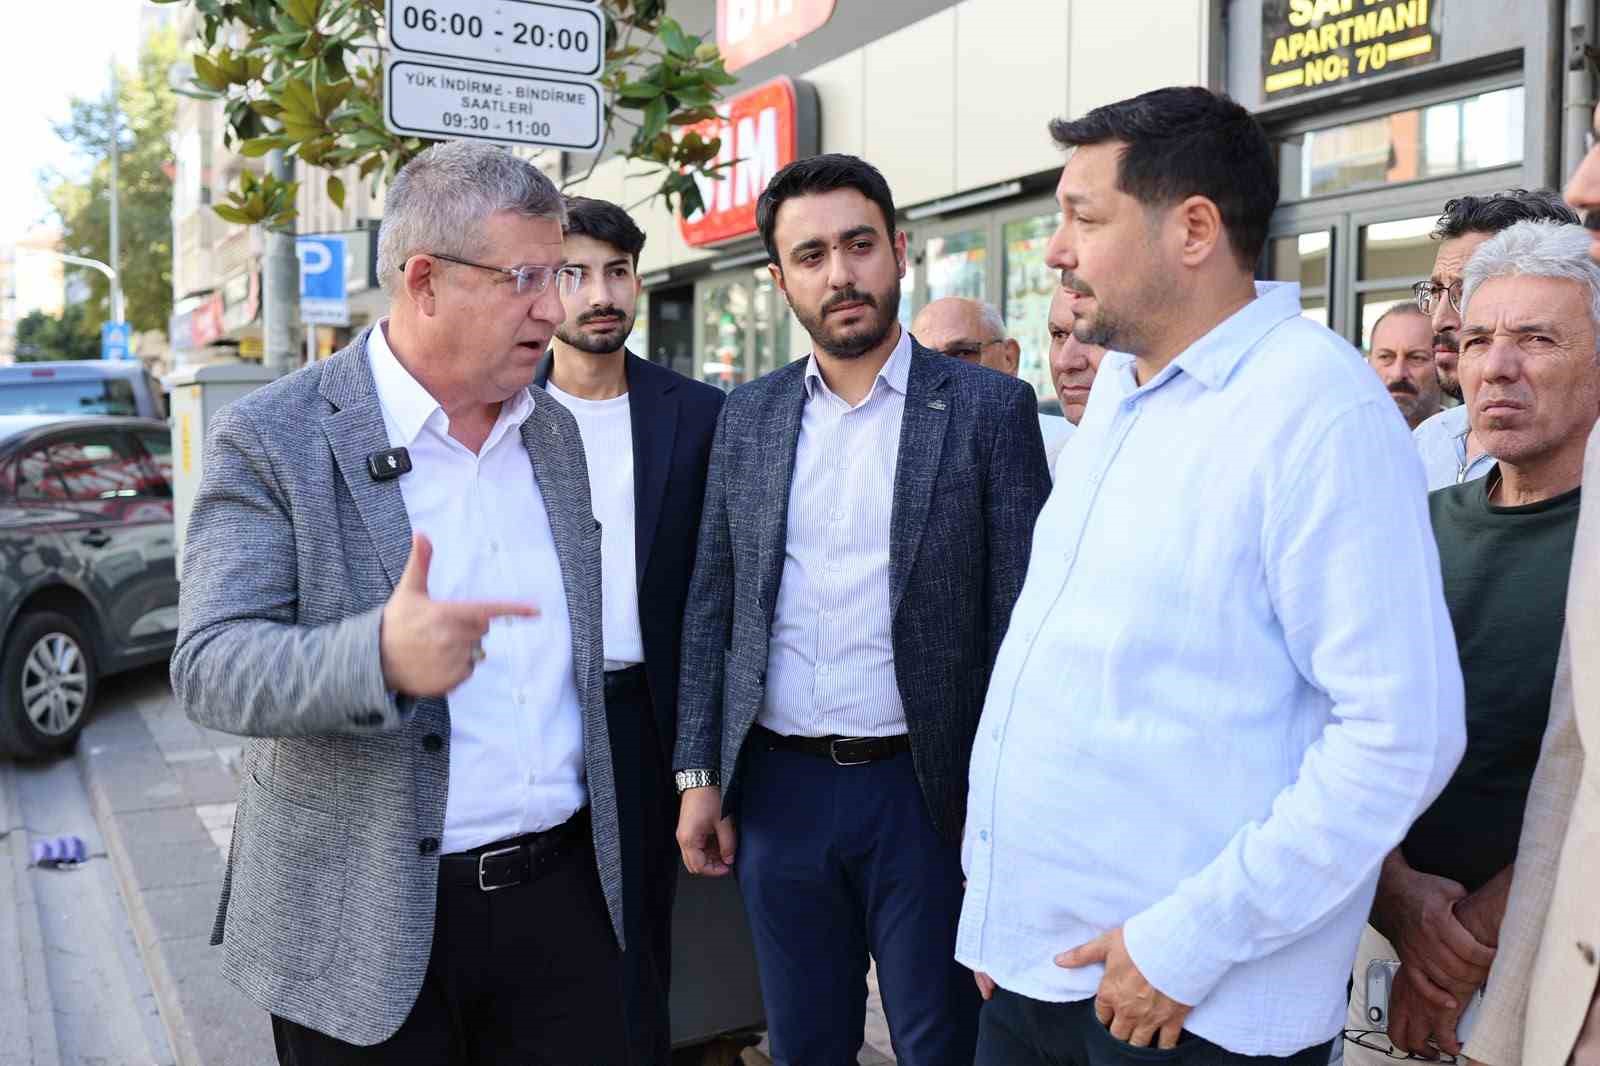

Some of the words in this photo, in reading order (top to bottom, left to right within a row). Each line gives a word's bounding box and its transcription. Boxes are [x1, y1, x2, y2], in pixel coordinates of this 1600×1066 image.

[403, 6, 483, 38] 06:00
[513, 22, 588, 52] 20:00
[1270, 0, 1428, 65] APARTMANI
[1305, 54, 1349, 87] NO:
[1355, 42, 1387, 74] 70
[405, 71, 437, 88] YÜK
[440, 74, 503, 96] İNDİRME
[515, 86, 586, 106] BİNDİRME
[461, 96, 533, 116] SAATLERİ
[442, 111, 489, 131] 09:30
[507, 119, 551, 137] 11:00
[295, 240, 333, 296] P
